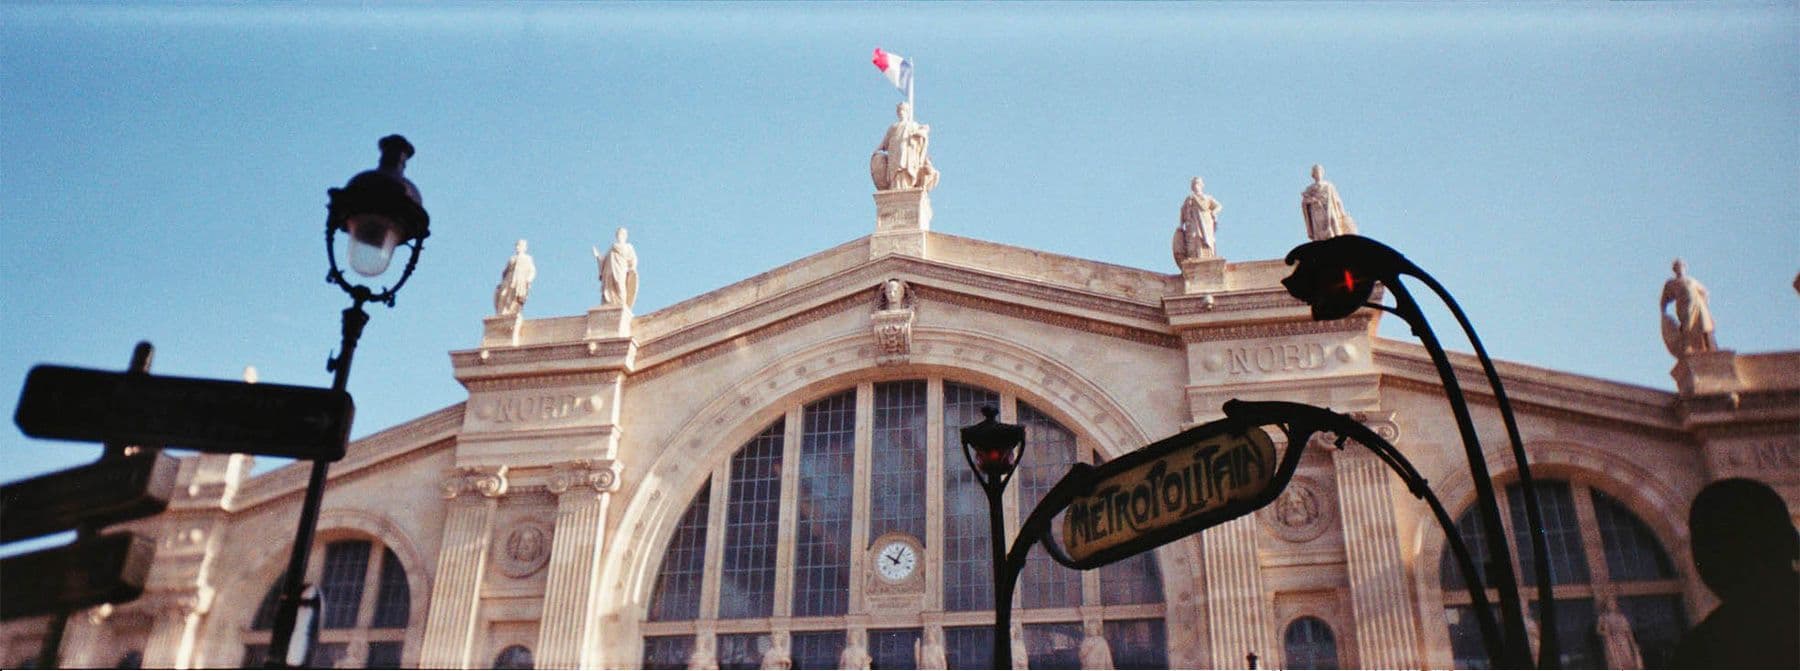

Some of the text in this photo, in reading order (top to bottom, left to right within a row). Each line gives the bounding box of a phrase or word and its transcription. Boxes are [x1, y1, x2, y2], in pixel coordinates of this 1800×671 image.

[1227, 343, 1327, 375] NORD
[494, 394, 581, 423] NORD
[1071, 436, 1266, 547] METROPOLITAIN
